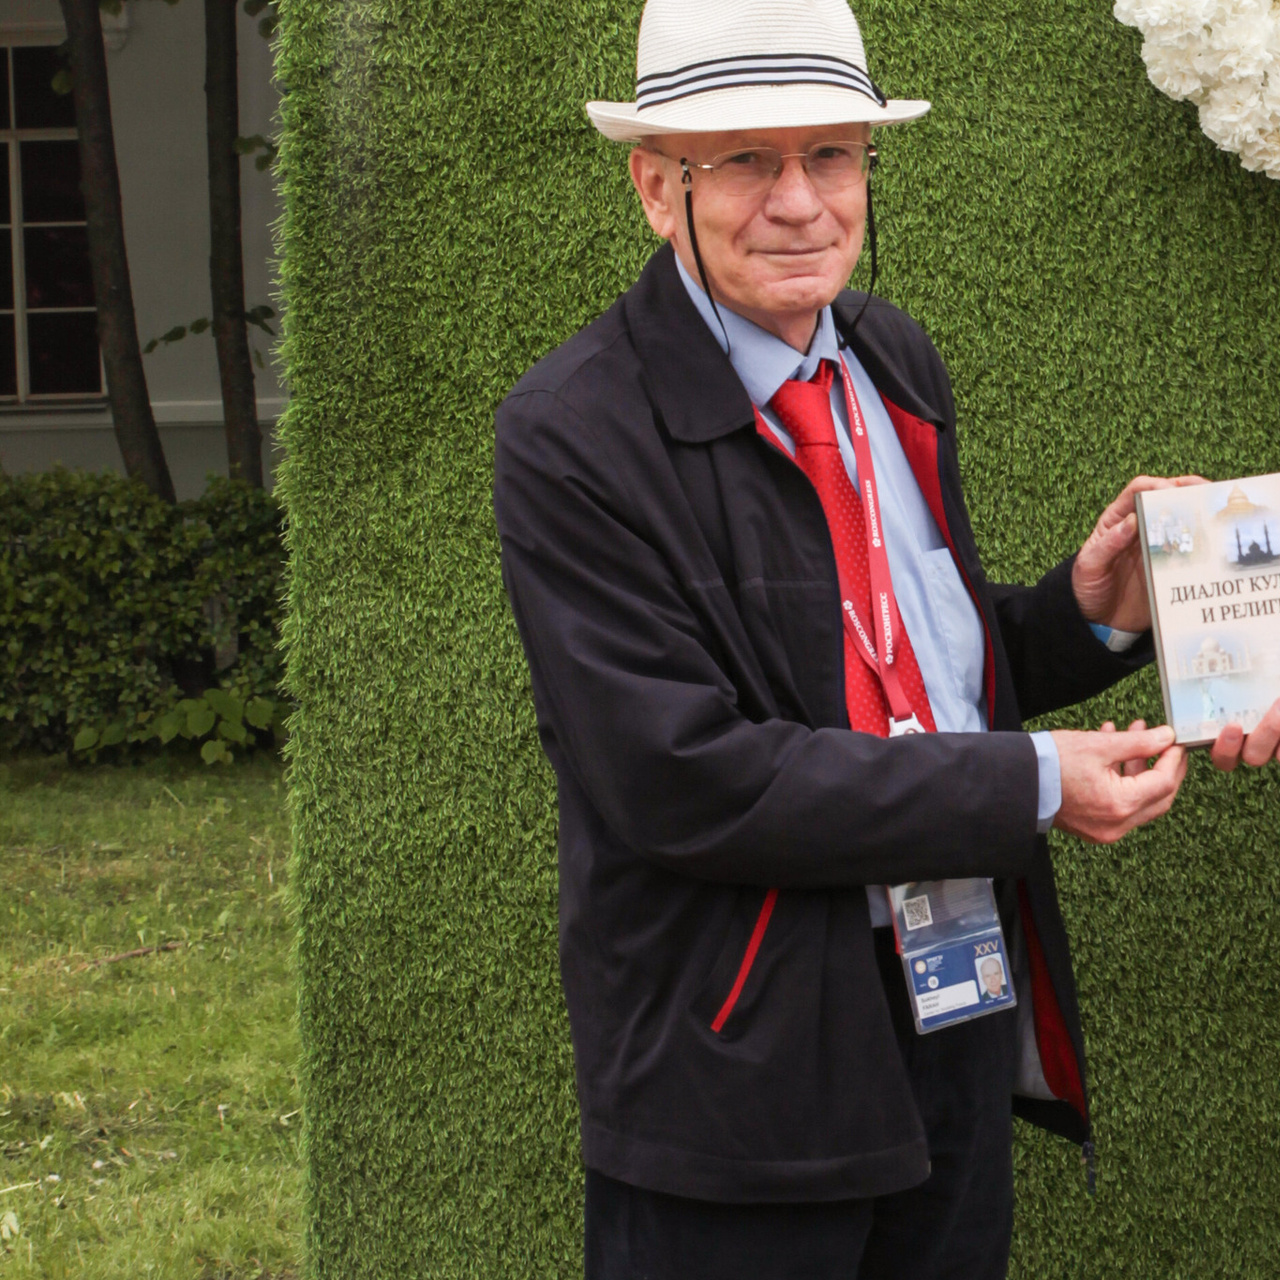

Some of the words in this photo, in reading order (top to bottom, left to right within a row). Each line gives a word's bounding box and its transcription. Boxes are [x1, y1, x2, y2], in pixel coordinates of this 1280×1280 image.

[865, 479, 879, 537] ROSCONGRESS
[1170, 578, 1244, 606] ДИАЛОГ
[880, 592, 893, 654] РОСКОНГРЕСС
[1201, 607, 1216, 624] И
[973, 940, 999, 957] XXV
